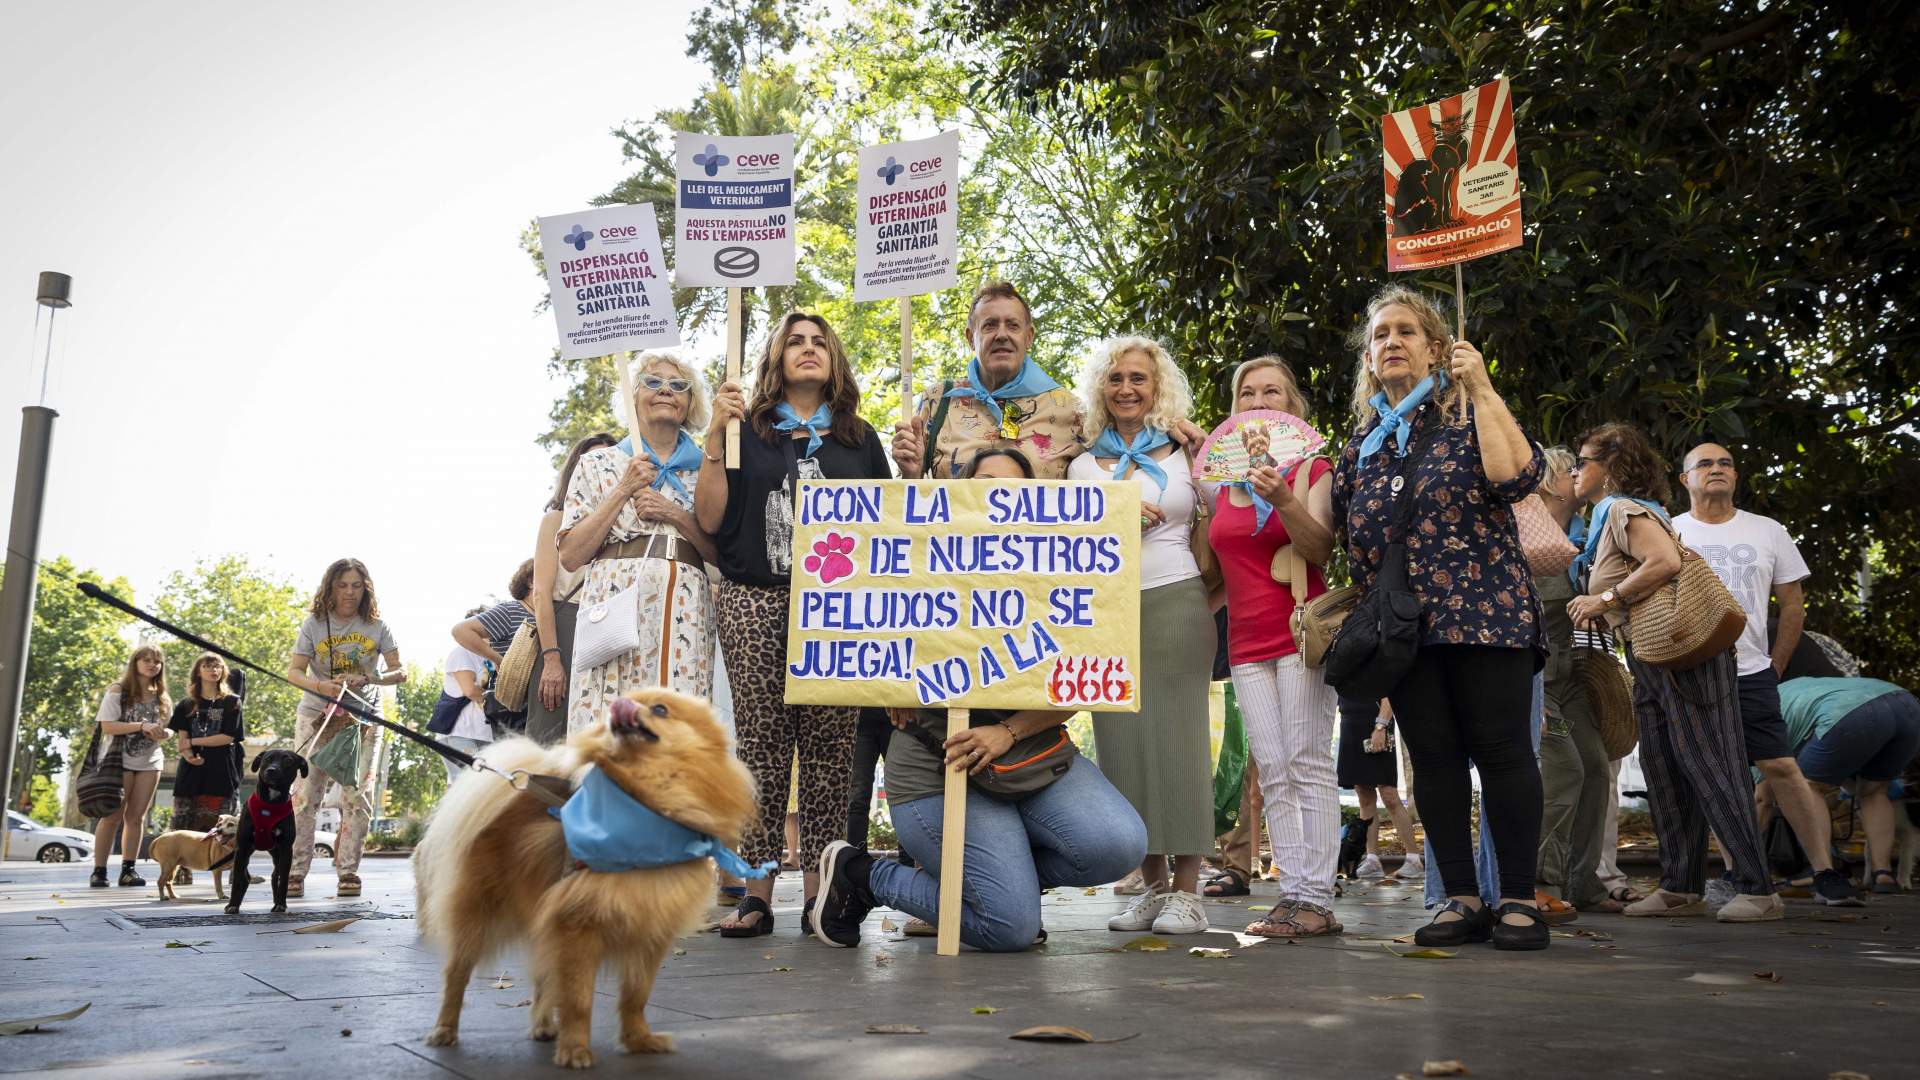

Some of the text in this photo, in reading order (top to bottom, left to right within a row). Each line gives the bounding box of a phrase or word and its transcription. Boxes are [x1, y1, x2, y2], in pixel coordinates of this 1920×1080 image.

[736, 153, 780, 167] ceve
[909, 156, 942, 173] ceve
[687, 183, 785, 195] LLEI DEL MEDICAMENT
[1462, 170, 1509, 187] VETERINARIS
[1467, 180, 1504, 194] SANITARIS
[710, 195, 764, 205] VETERINARI
[869, 180, 947, 210] DISPENSACIÓ
[686, 219, 726, 228] AQUESTA
[869, 200, 947, 226] VETERINÀRIA
[600, 226, 637, 239] ceve
[686, 228, 786, 242] ENS L'EMPASSEM
[878, 217, 938, 240] GARANTIA
[1396, 215, 1511, 251] CONCENTRACIÓ
[876, 233, 938, 256] SANITÀRIA
[560, 248, 649, 274] DISPENSACIÓ
[863, 267, 901, 279] medicaments
[902, 262, 933, 273] veterinaris
[941, 257, 950, 265] els
[877, 261, 887, 269] Per
[888, 260, 894, 268] la
[894, 257, 913, 266] venda
[929, 253, 937, 261] de
[866, 267, 946, 286] Centres Sanitaris Veterinaris
[576, 280, 646, 301] GARANTIA
[577, 294, 650, 316] SANITÀRIA
[567, 325, 611, 339] medicaments
[612, 320, 648, 330] veterinaris
[582, 321, 594, 329] Per
[602, 316, 623, 325] venda
[623, 314, 641, 322] lliure
[573, 327, 665, 345] Centres Sanitaris Veterinaris
[801, 485, 1104, 526] ¡CON LA SALUD
[871, 534, 1121, 575] DE NUESTROS
[1692, 544, 1758, 565] RO
[801, 587, 1094, 630] PELUDOS NO SE
[789, 637, 914, 680] JUEGA!
[916, 621, 1129, 704] NO A LA 666
